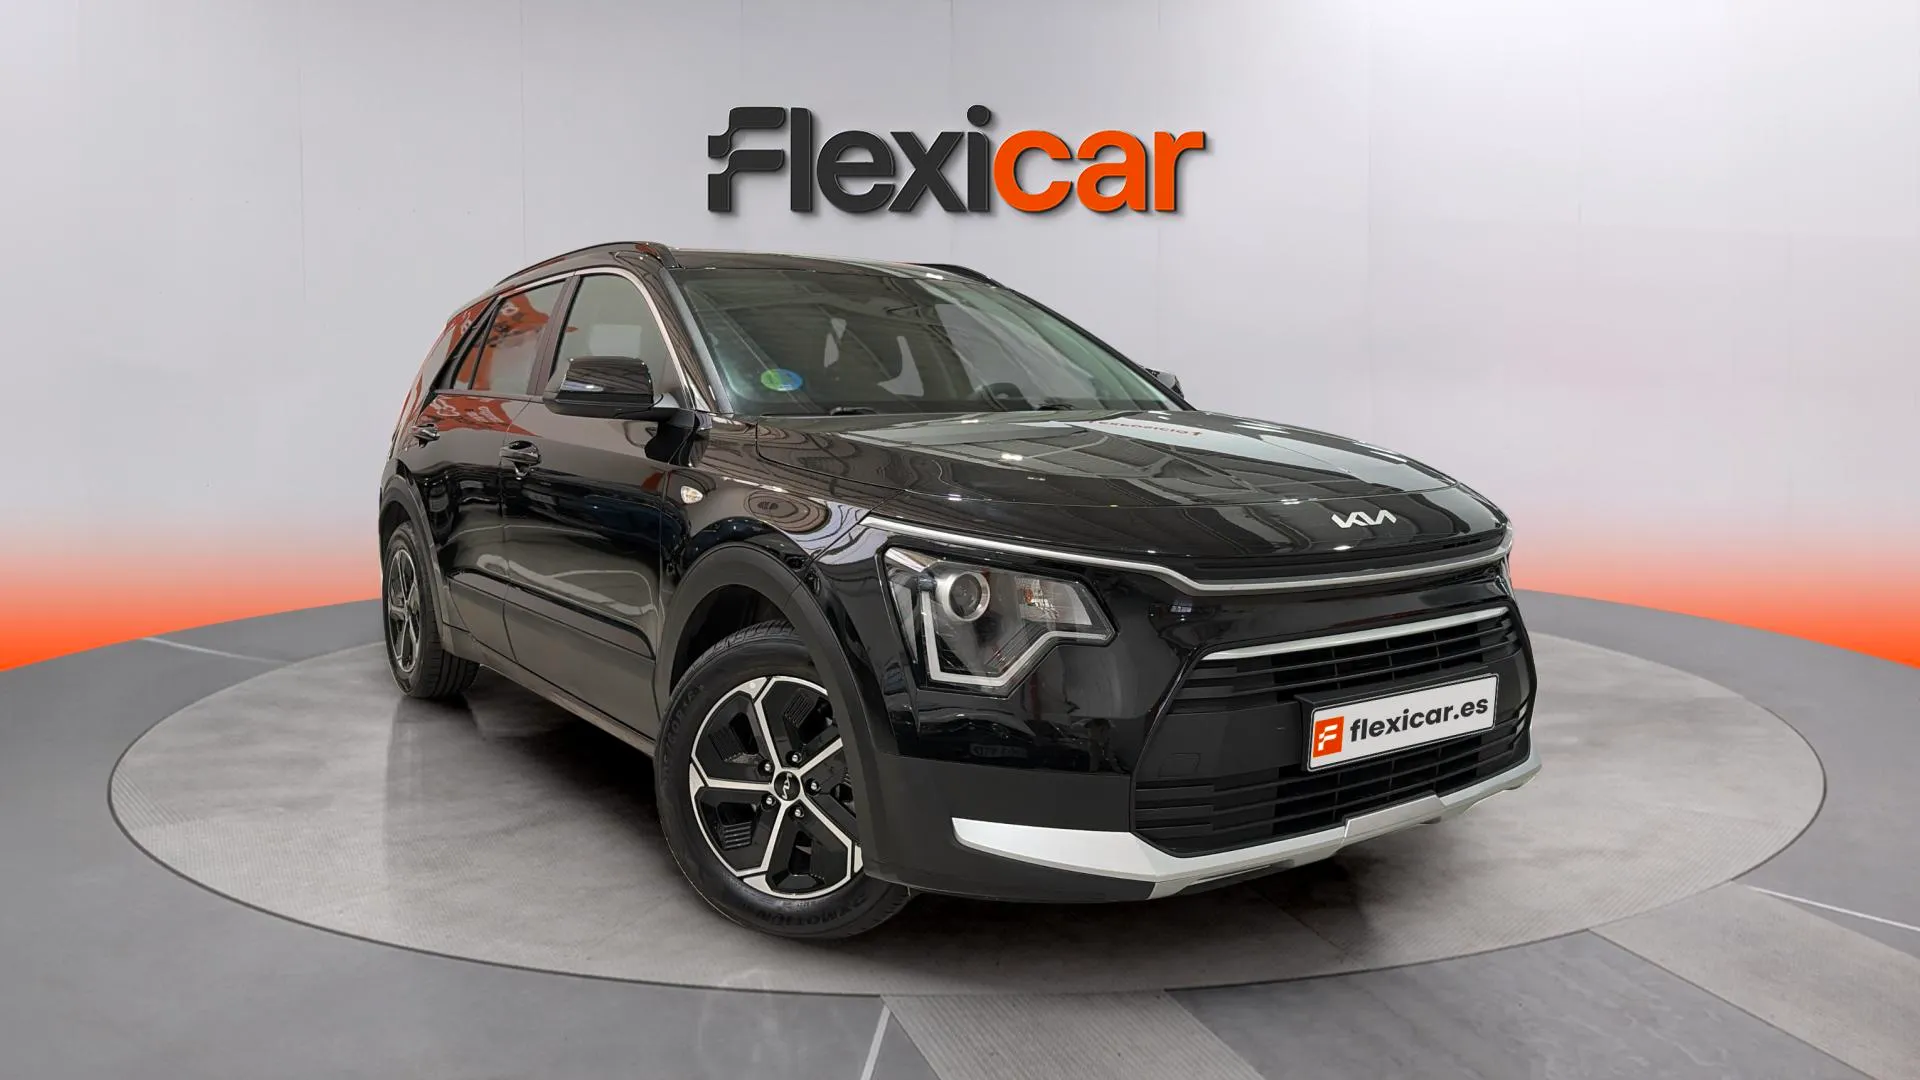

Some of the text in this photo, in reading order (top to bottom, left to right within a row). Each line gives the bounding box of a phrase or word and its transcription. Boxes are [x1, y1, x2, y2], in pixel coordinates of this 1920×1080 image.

[708, 104, 1205, 212] Flexicar
[1331, 509, 1397, 528] KIA
[1350, 698, 1488, 742] flexicar.es
